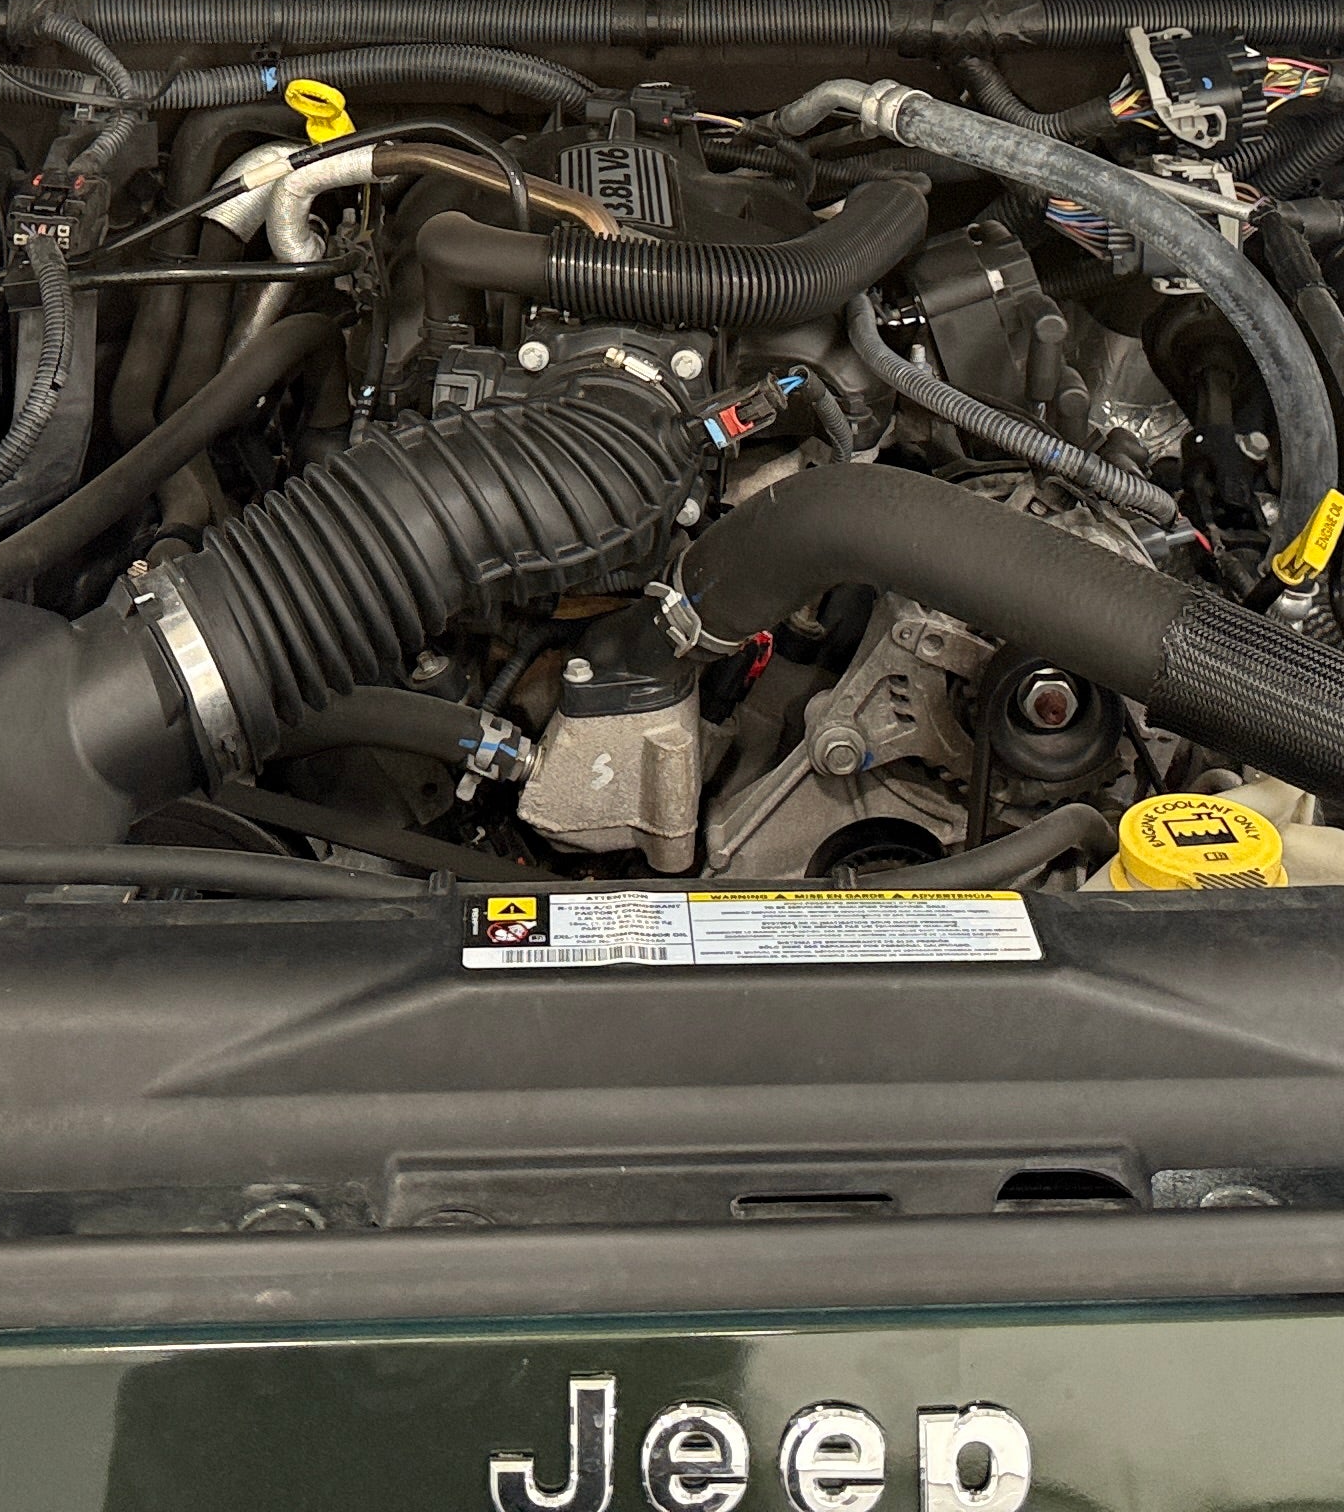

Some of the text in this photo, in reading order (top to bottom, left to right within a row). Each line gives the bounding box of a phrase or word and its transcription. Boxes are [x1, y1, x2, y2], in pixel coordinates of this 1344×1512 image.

[594, 148, 635, 216] 3.8L V6
[1141, 800, 1261, 848] ENGINE COOLANT ONLY
[489, 1370, 1033, 1512] Jeep
